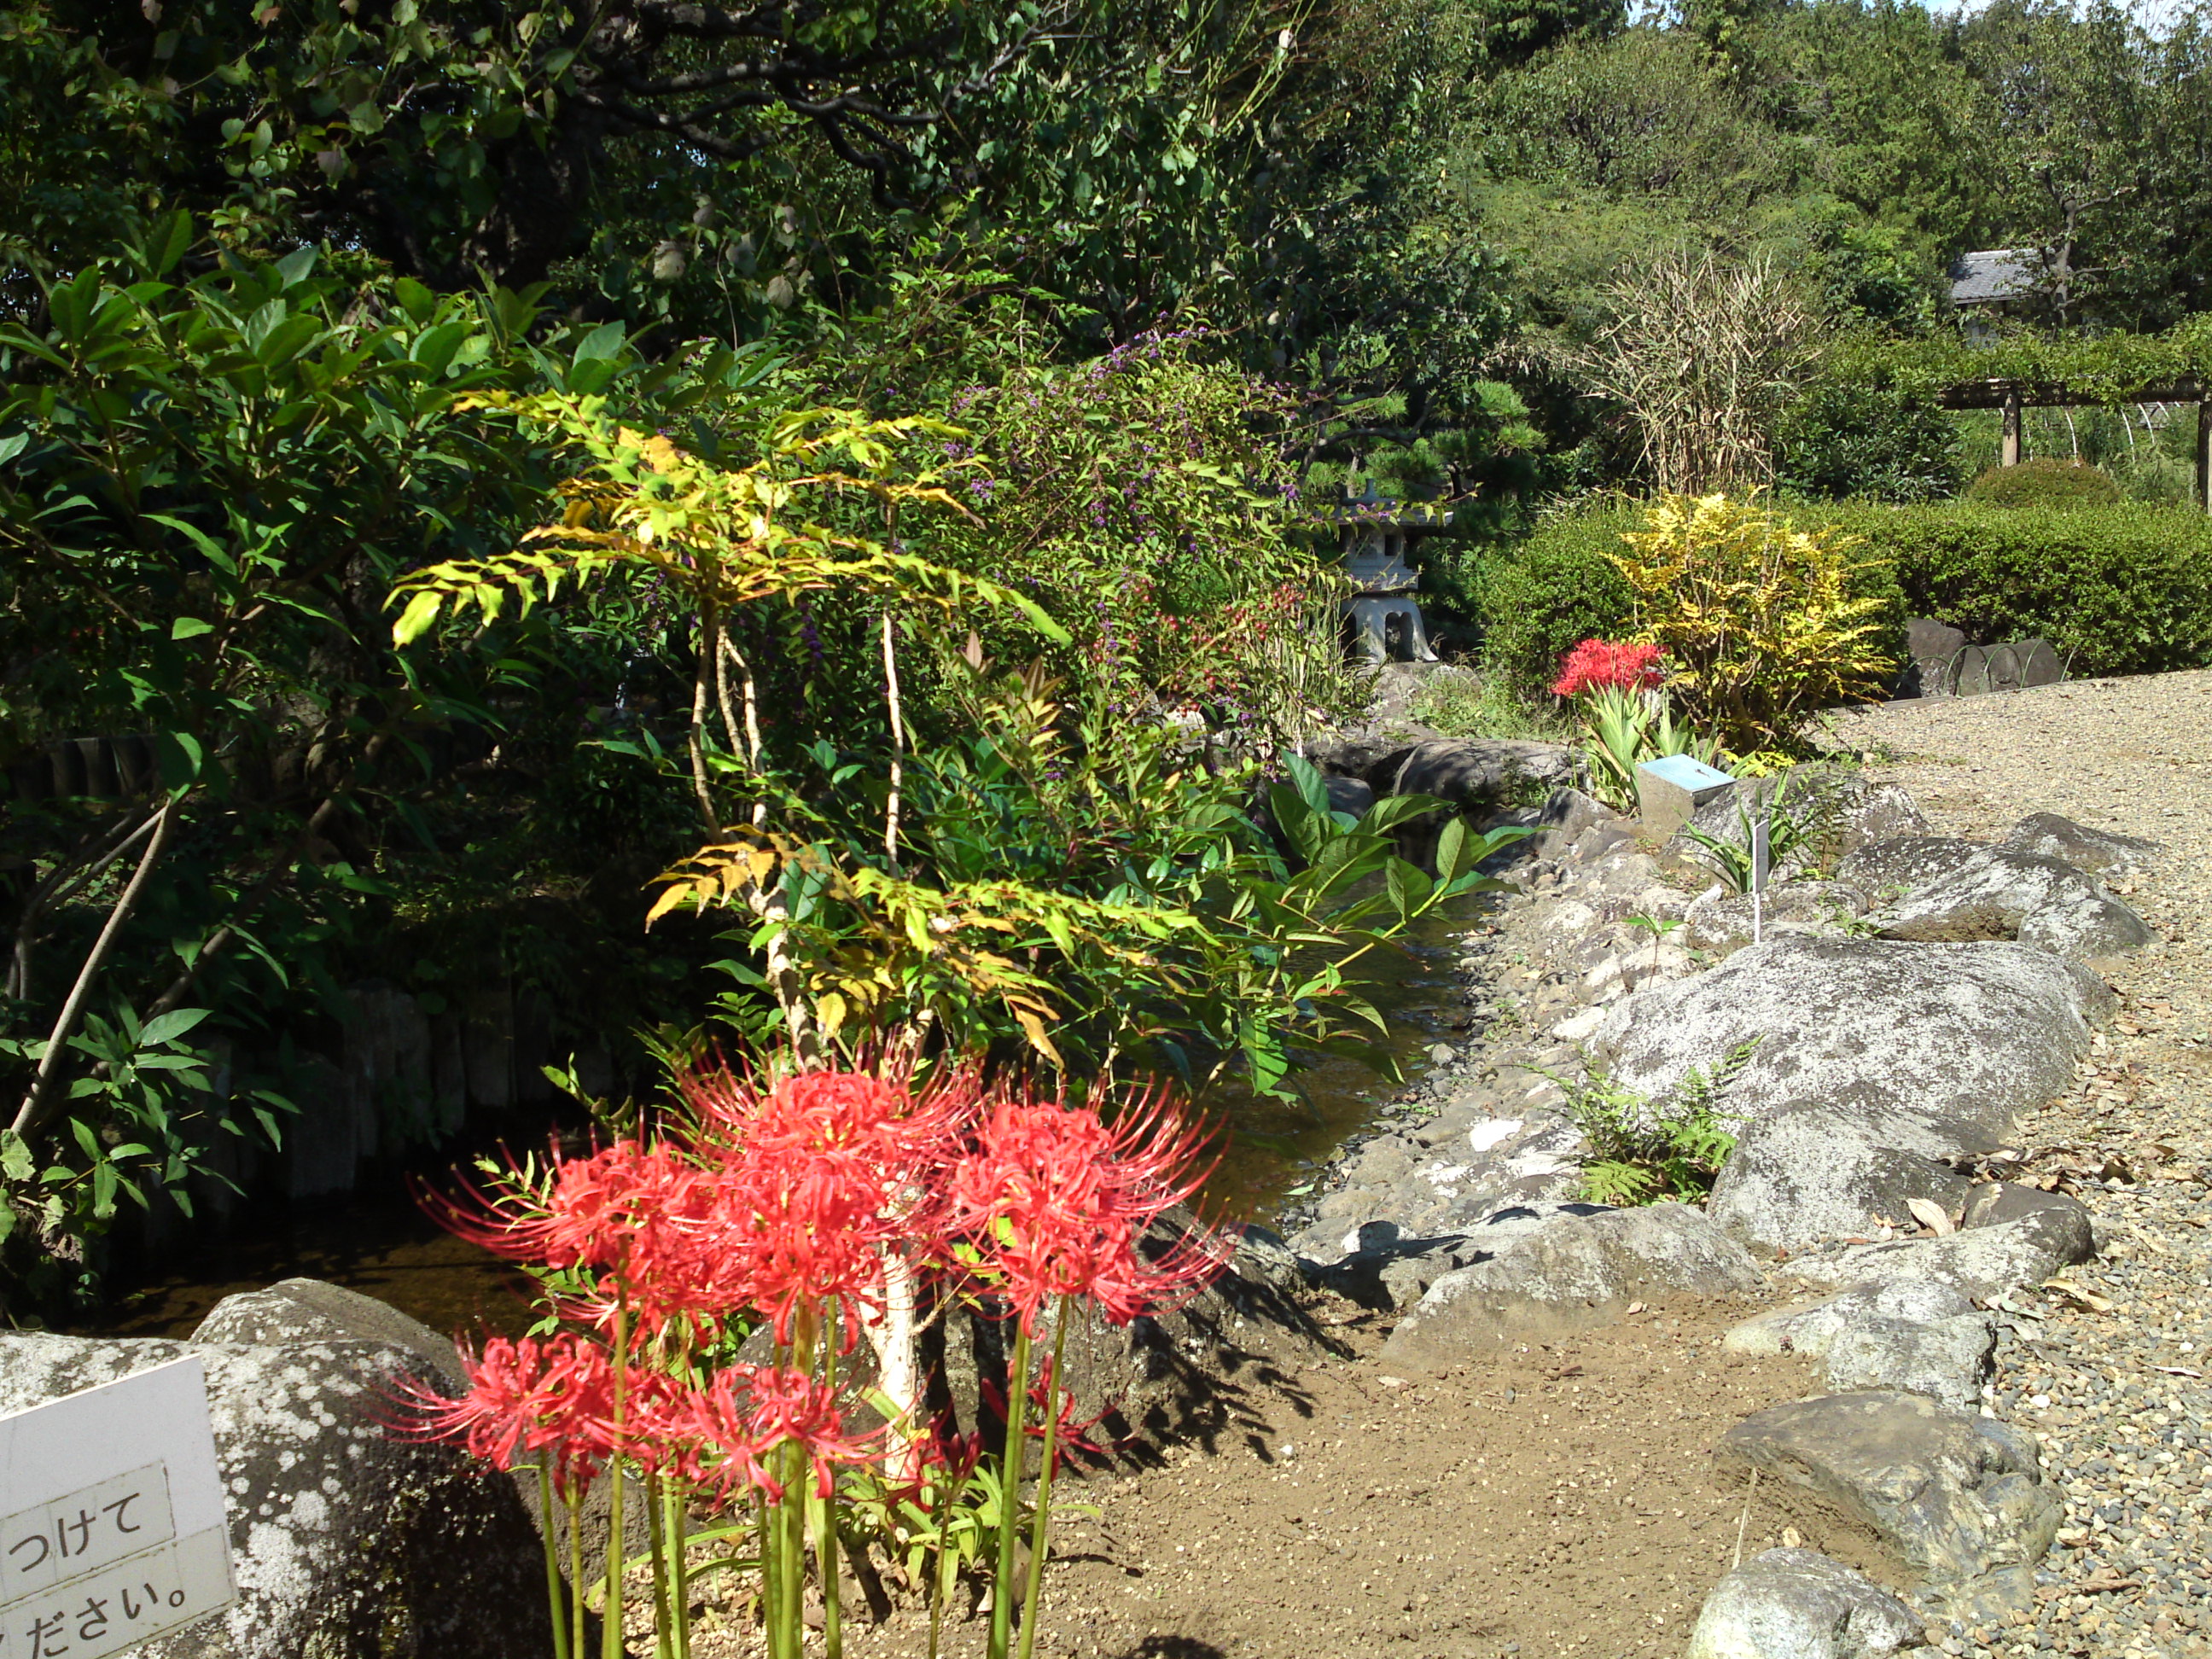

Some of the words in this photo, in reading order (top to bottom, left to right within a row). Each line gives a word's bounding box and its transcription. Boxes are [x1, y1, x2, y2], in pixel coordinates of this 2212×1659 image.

[9, 1493, 140, 1572] つけて
[0, 1582, 185, 1659] ださい。
